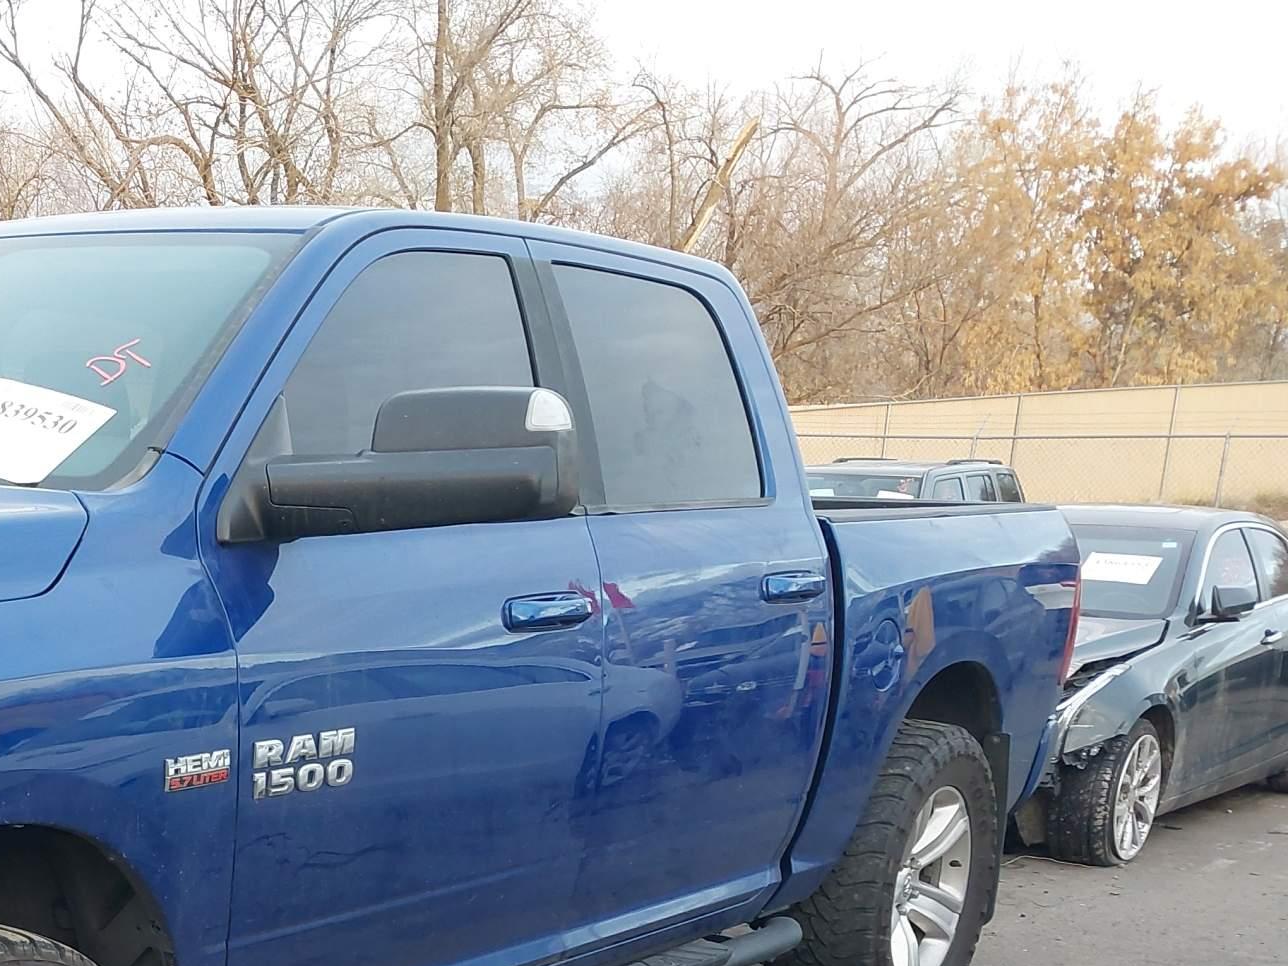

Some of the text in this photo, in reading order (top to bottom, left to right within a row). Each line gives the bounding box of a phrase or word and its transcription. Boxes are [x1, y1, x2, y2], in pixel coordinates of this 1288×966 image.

[165, 749, 230, 777] HEMI
[253, 728, 355, 769] RAM
[169, 768, 228, 790] 5.7 LITER
[252, 758, 353, 800] 1500
